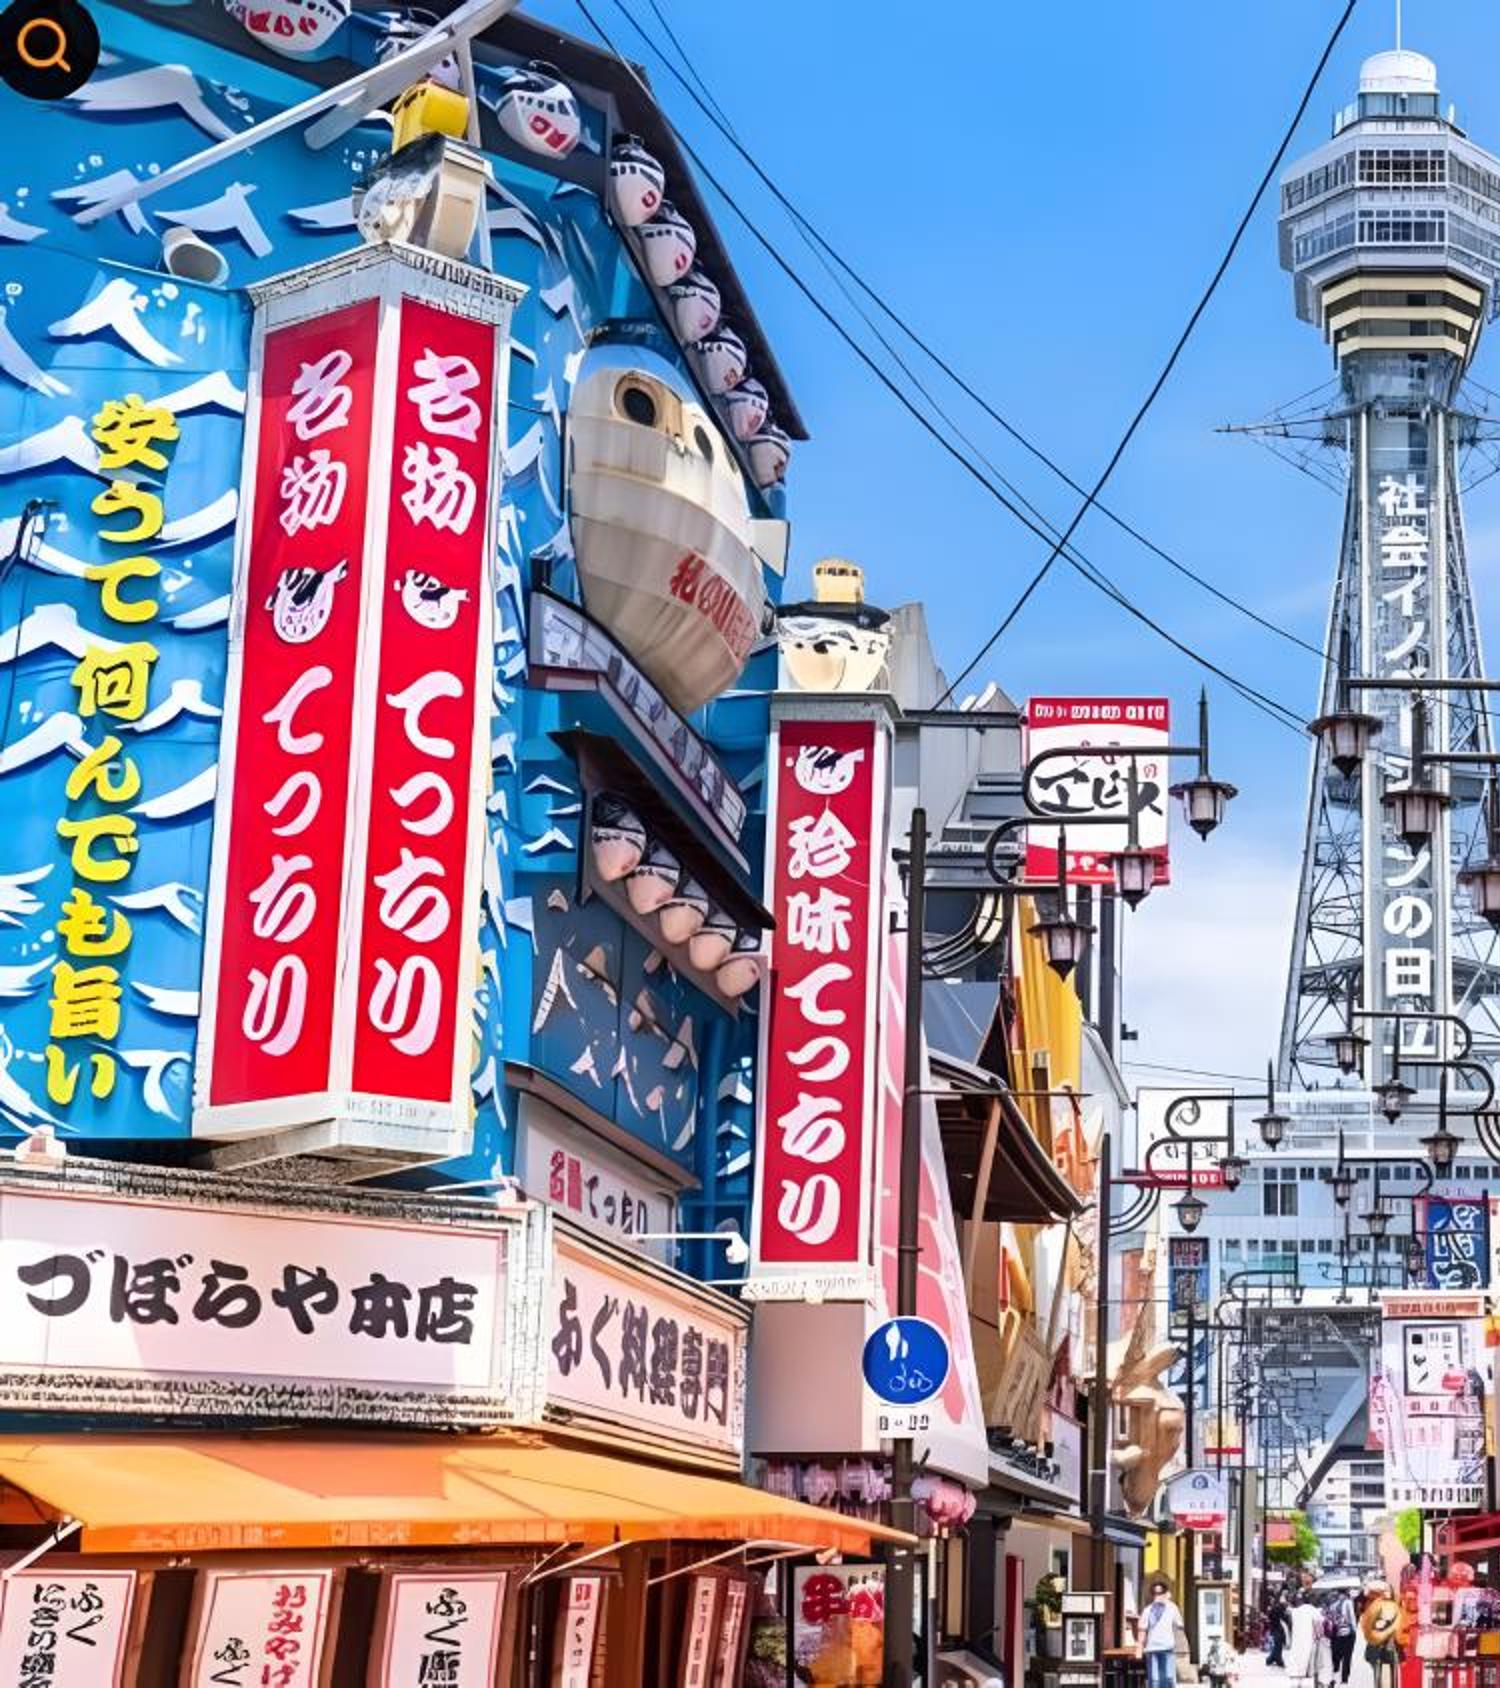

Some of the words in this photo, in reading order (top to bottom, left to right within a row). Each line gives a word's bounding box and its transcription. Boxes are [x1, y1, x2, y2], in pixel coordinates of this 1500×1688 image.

[401, 347, 482, 535] 名物
[46, 393, 180, 1105] 安うて何んでも旨い
[242, 664, 333, 1057] てっちり
[367, 669, 464, 1057] てっちり
[777, 807, 856, 1245] 珍味てっちり
[18, 1248, 479, 1345] づぼらや本店
